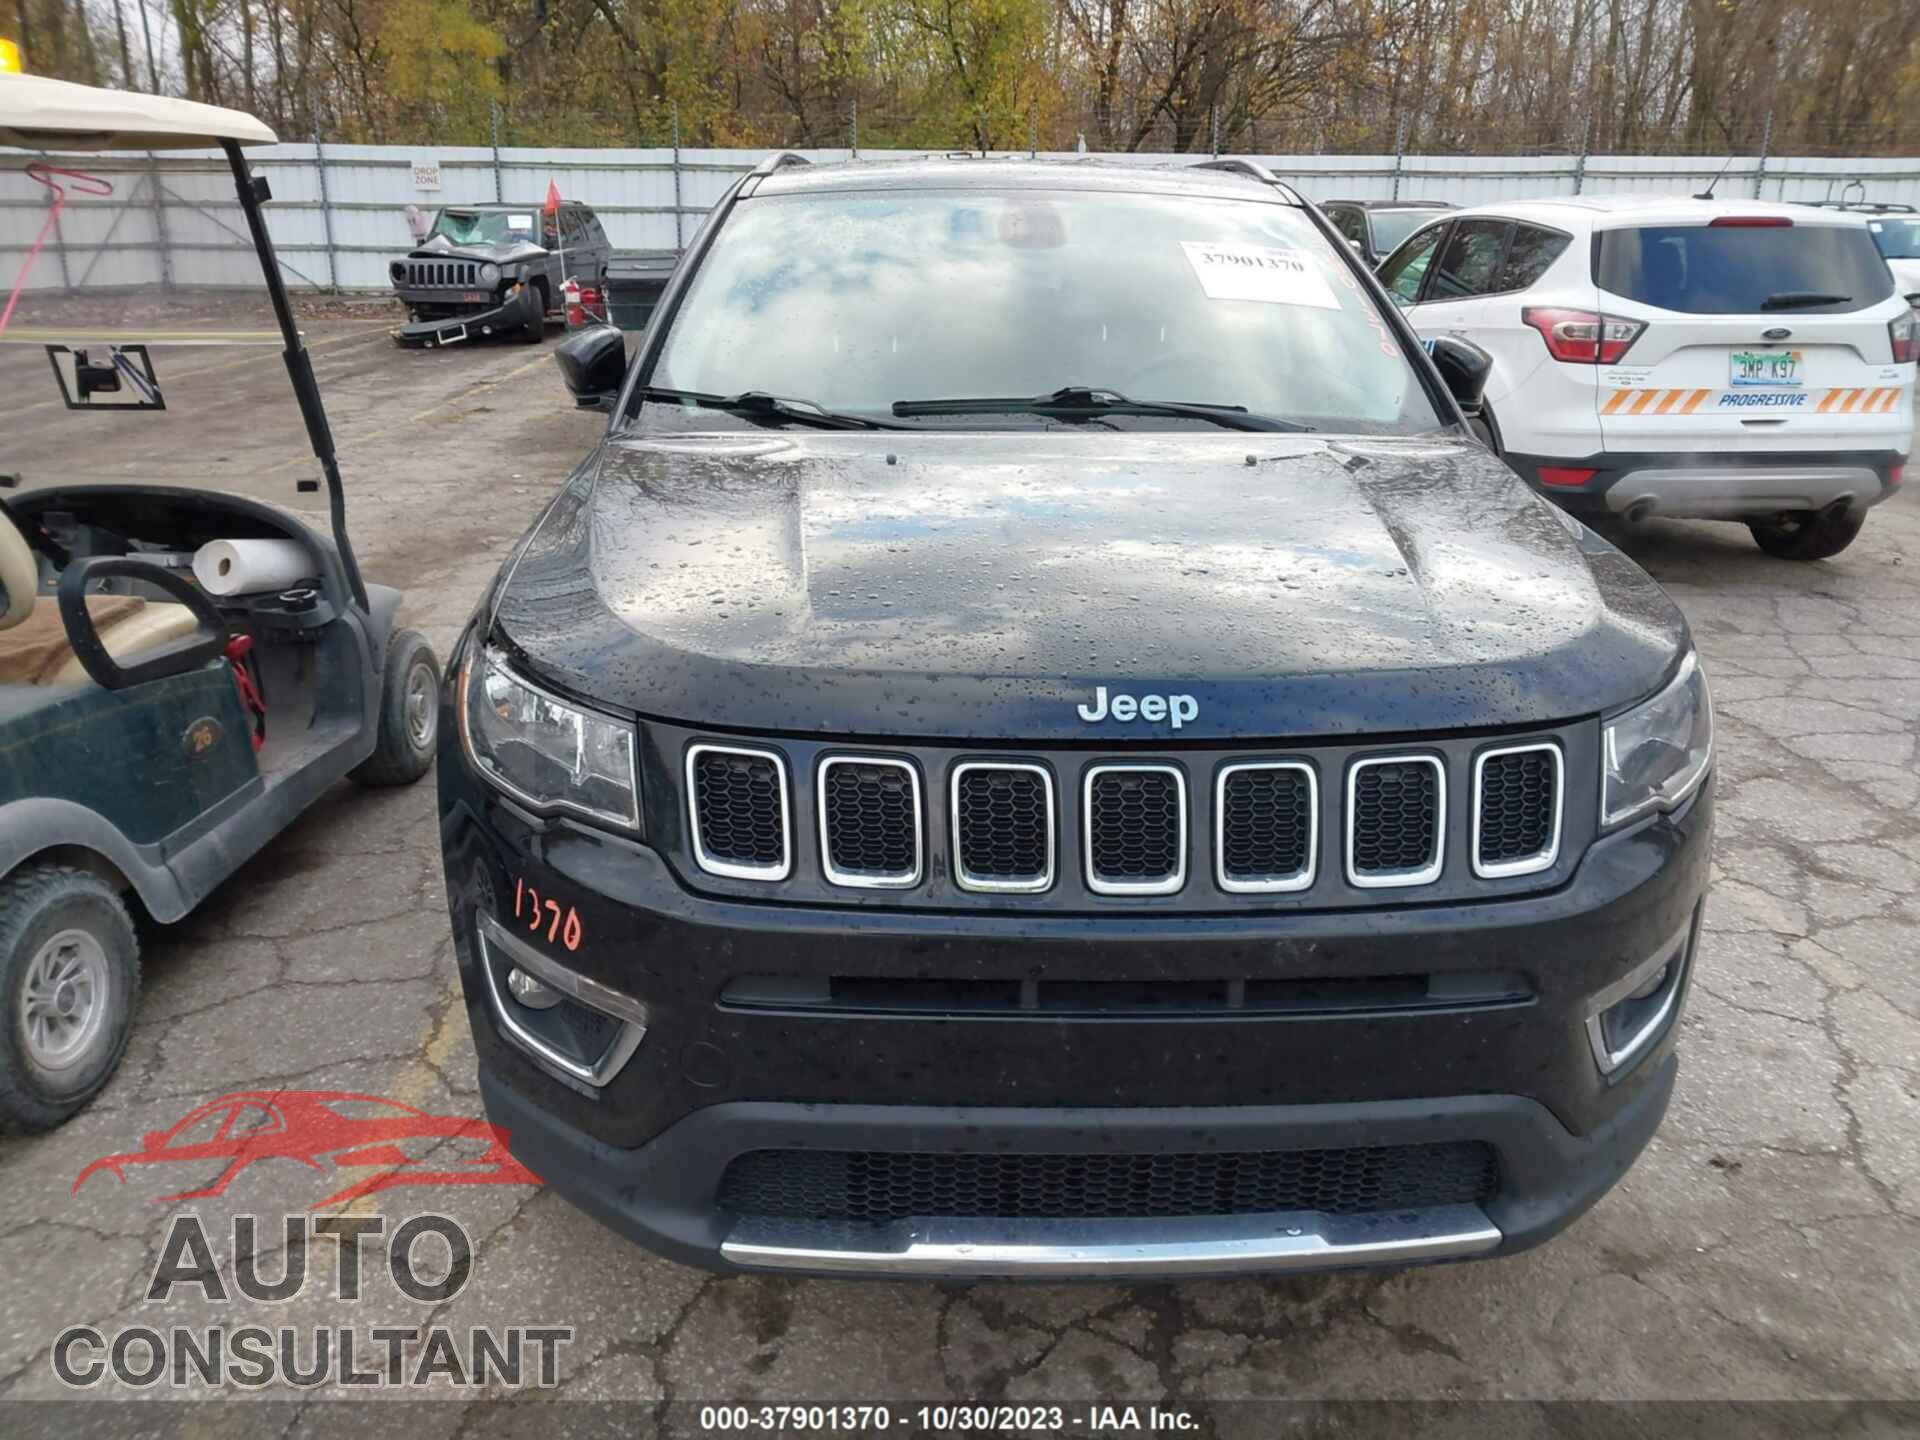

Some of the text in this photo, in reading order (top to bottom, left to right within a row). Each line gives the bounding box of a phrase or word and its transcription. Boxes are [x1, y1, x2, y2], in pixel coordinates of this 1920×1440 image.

[415, 175, 440, 185] ZONE
[1201, 252, 1304, 272] 37901370
[1739, 359, 1796, 378] 3MP K97
[1718, 393, 1808, 407] PROGRESSIVE
[1077, 686, 1199, 728] Jeep
[515, 878, 581, 951] 1370
